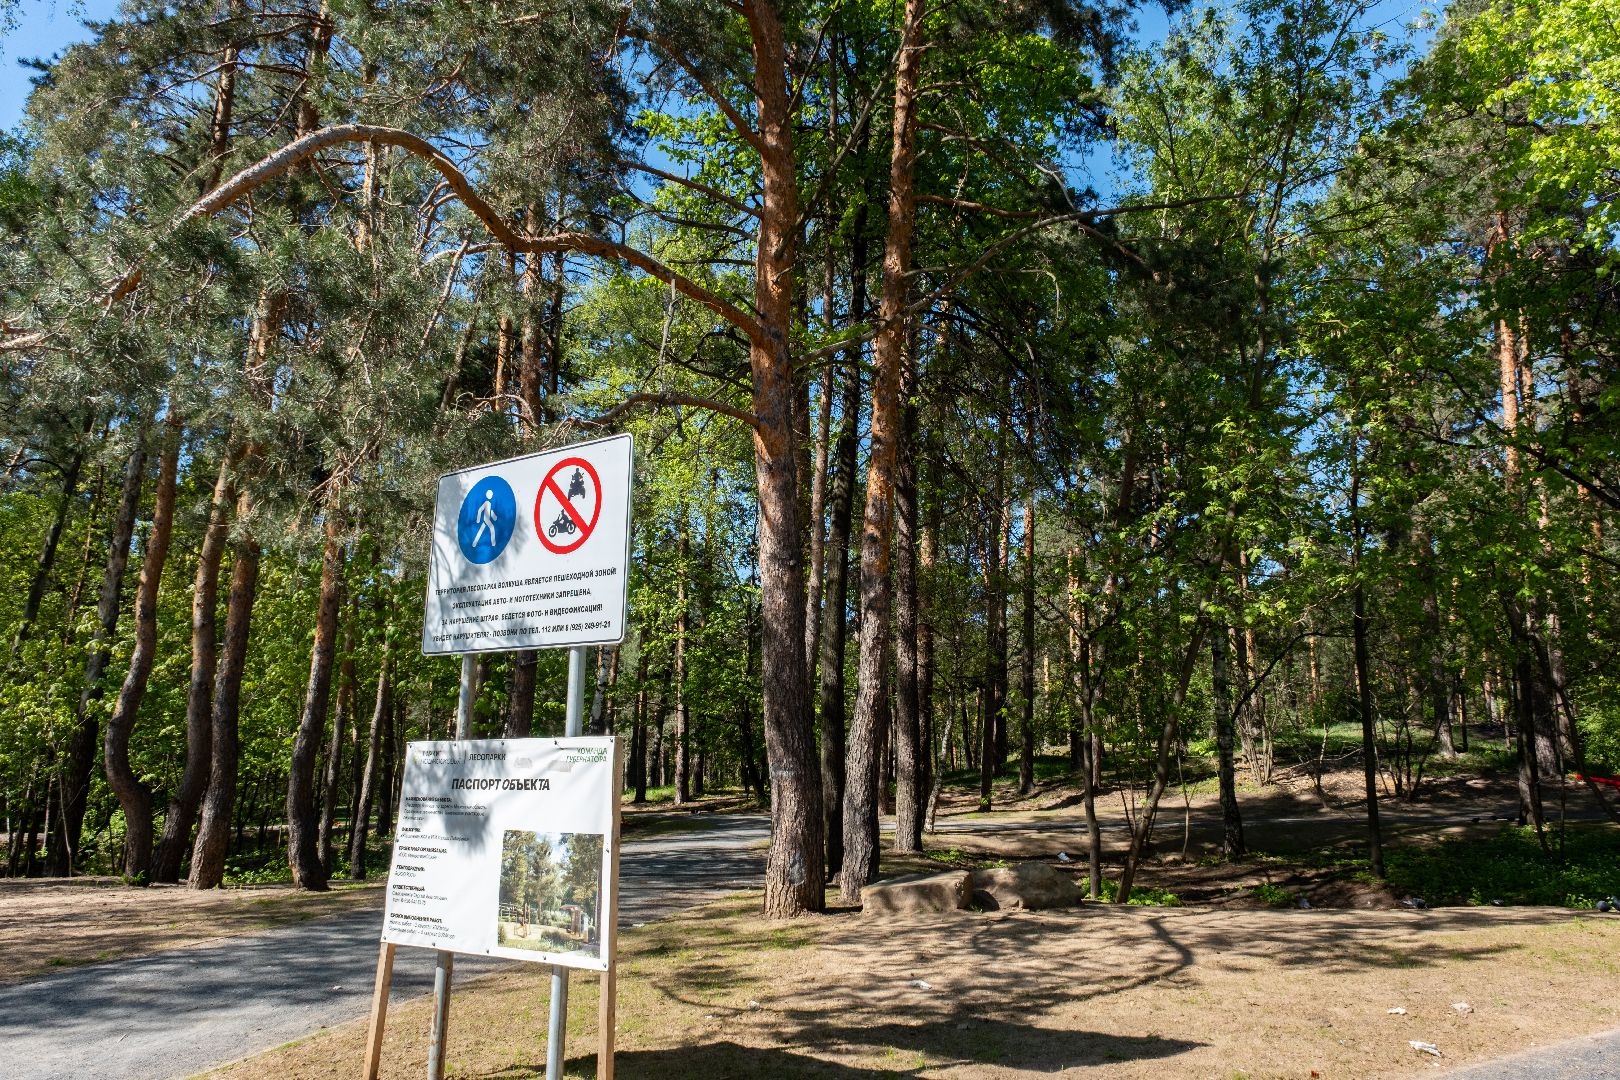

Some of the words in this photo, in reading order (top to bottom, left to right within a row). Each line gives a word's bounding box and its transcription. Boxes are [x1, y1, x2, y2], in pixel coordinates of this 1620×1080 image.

[467, 583, 497, 592] ЛЕСОПАРКА
[524, 576, 552, 586] ЯВЛЯЕТСЯ
[554, 569, 594, 582] ПЕШЕХОДНОЙ
[595, 566, 616, 577] ЗОНОЙ!
[452, 599, 492, 610] ЭКСПЛУАТАЦИЯ
[514, 592, 555, 602] МОТОТЕХНИКИ
[449, 616, 479, 625] НАРУШЕНИЕ
[501, 611, 525, 620] ВЕДЕТСЯ
[550, 603, 603, 616] ВИДЕОФИКСАЦИЯ!
[493, 628, 518, 637] ПОЗВОНИ
[452, 778, 502, 790] ПАСПОРТ
[502, 779, 550, 790] ОБЪЕКТА
